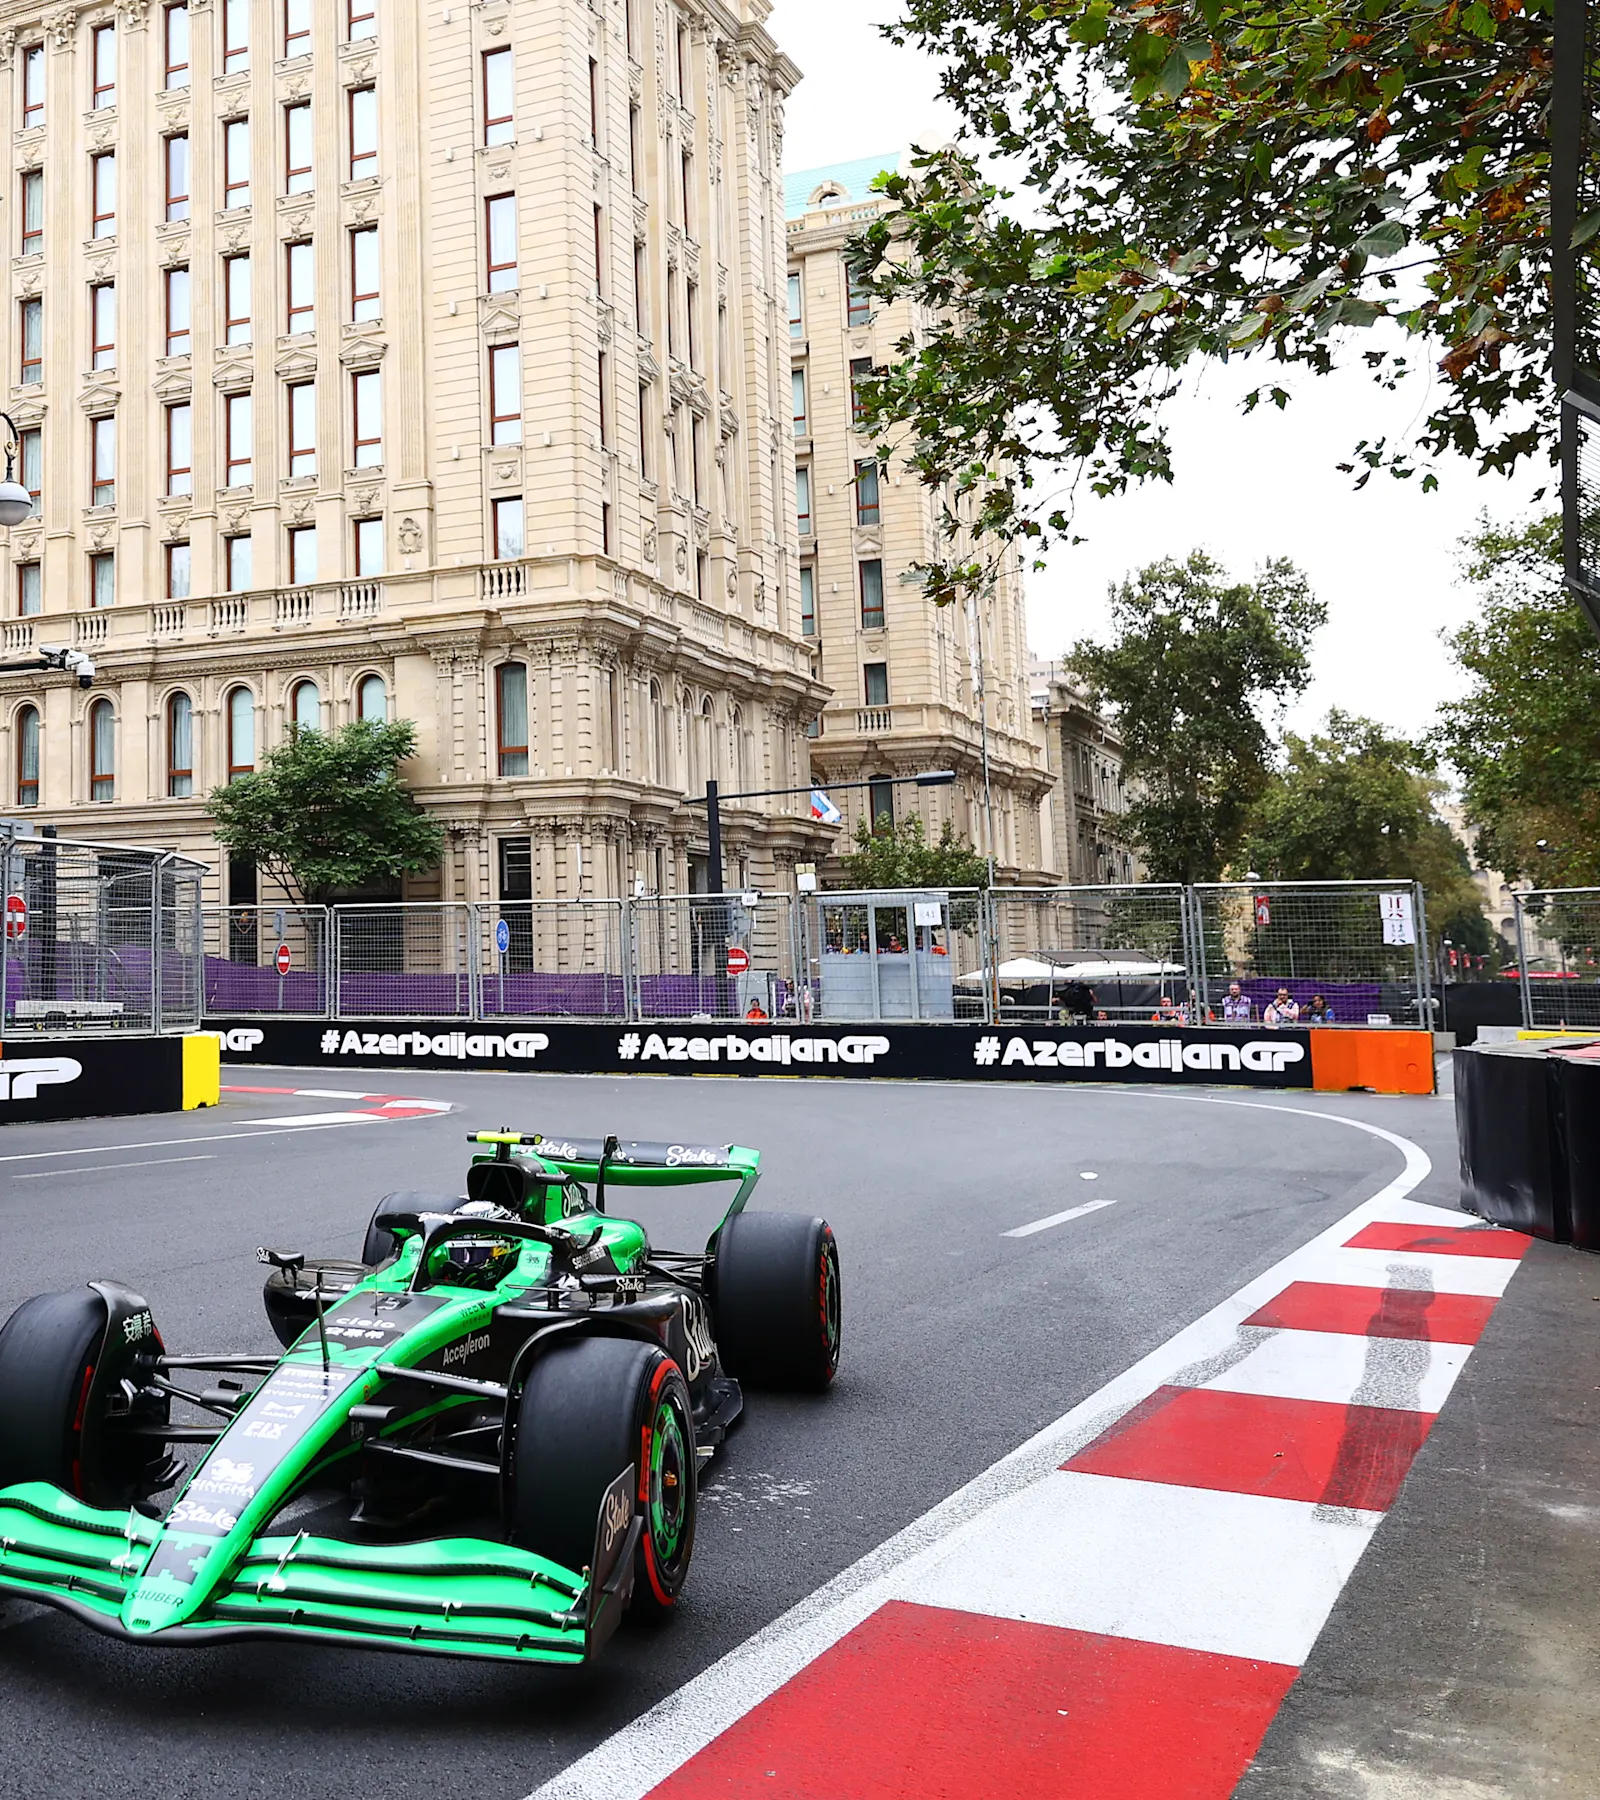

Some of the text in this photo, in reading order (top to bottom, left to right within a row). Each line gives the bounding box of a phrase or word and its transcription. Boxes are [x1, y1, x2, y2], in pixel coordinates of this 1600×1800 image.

[321, 1030, 549, 1060] #AzerbaijanGP
[618, 1033, 890, 1065] #AzerbaijanGP
[974, 1037, 1306, 1073] #AzerbaijanGP
[615, 1276, 645, 1293] Stake
[165, 1501, 237, 1531] Stake
[605, 1489, 630, 1552] Stake
[128, 1590, 184, 1608] SAUBER
